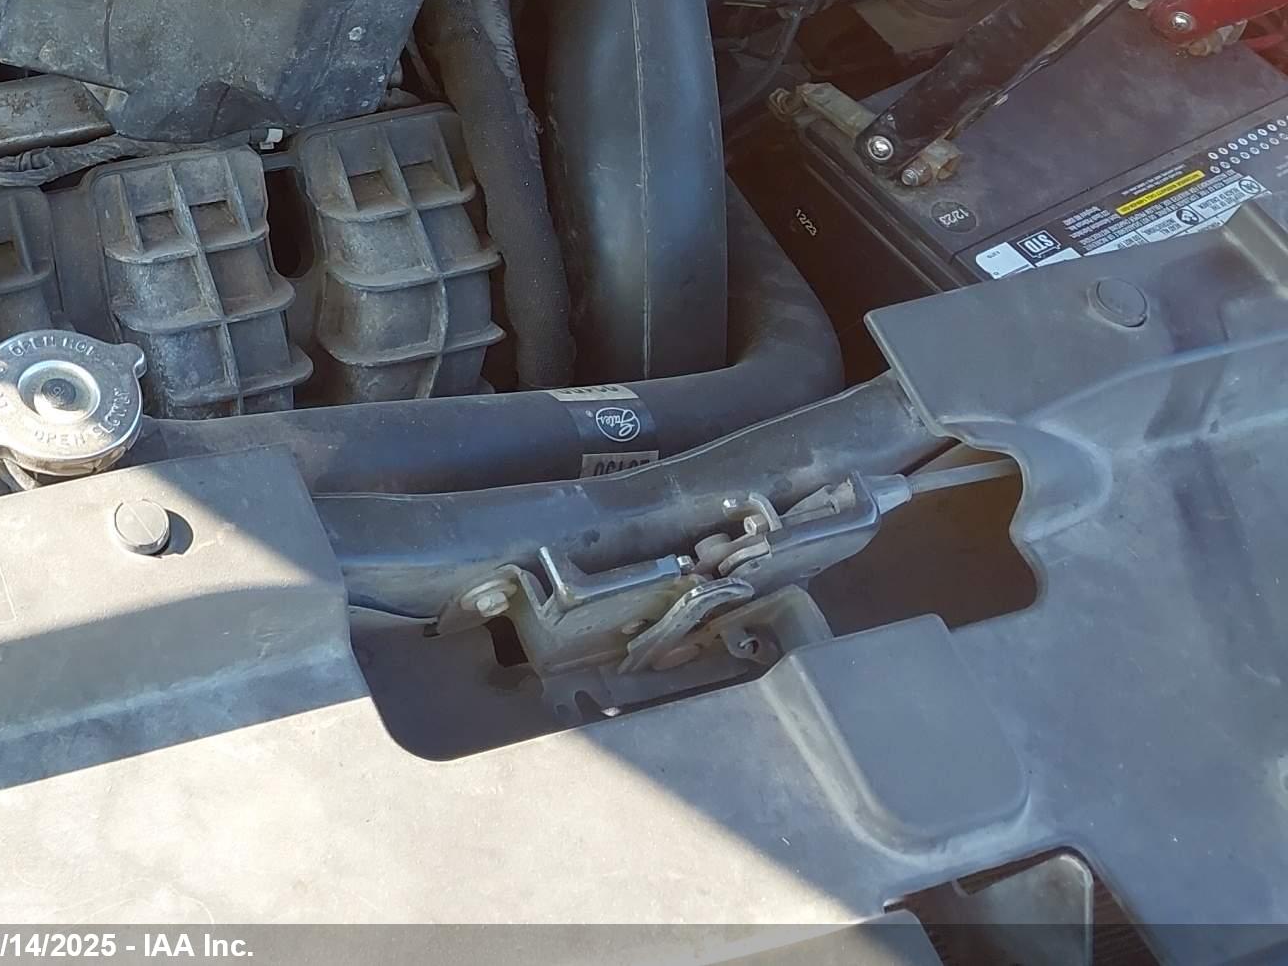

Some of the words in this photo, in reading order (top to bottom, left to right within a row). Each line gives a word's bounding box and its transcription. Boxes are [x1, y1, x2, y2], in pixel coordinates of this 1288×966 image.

[796, 208, 817, 236] 12/23
[1023, 234, 1054, 253] STD
[598, 407, 637, 438] Gates
[33, 431, 87, 447] OPEN
